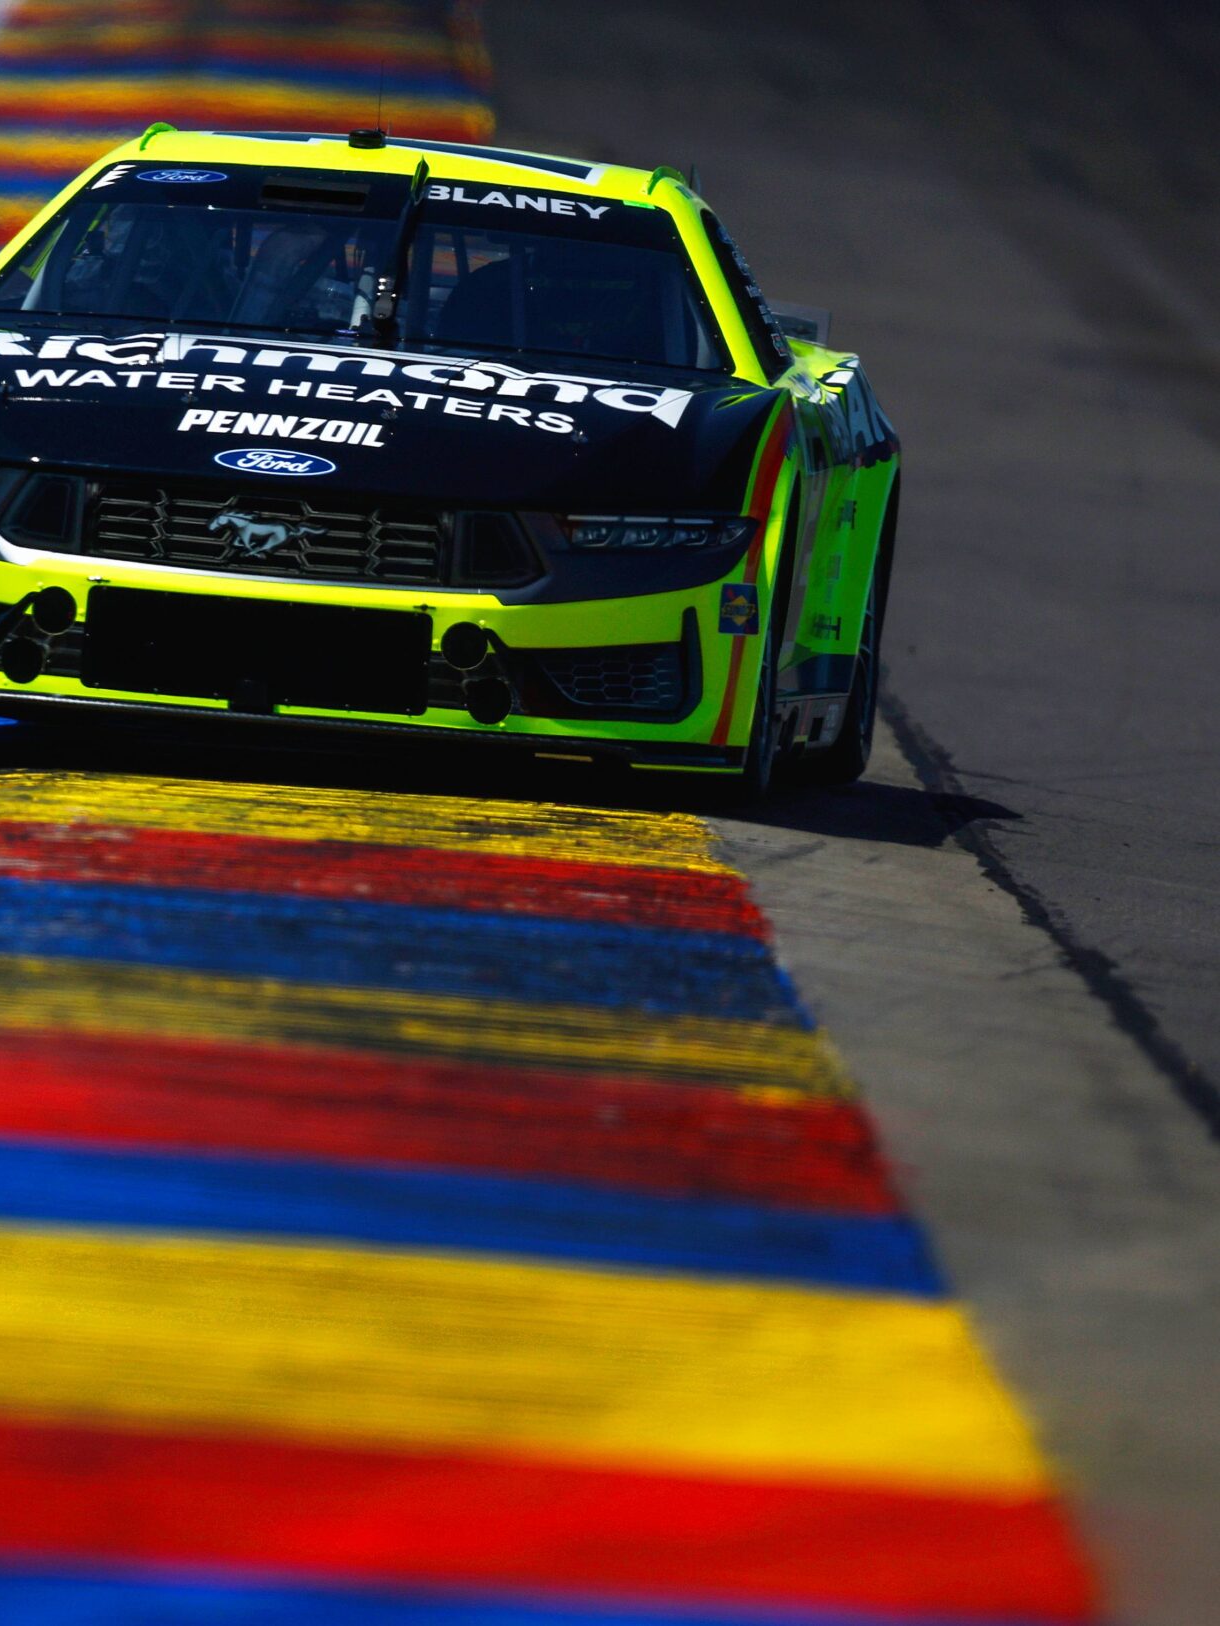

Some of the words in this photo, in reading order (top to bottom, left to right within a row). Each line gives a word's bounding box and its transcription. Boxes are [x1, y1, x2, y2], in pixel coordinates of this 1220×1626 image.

[151, 169, 211, 182] Ford
[424, 184, 611, 220] BLANEY
[14, 368, 246, 393] WATER
[267, 378, 576, 434] HEATERS
[177, 407, 386, 448] PENNZOIL
[236, 451, 314, 473] Ford
